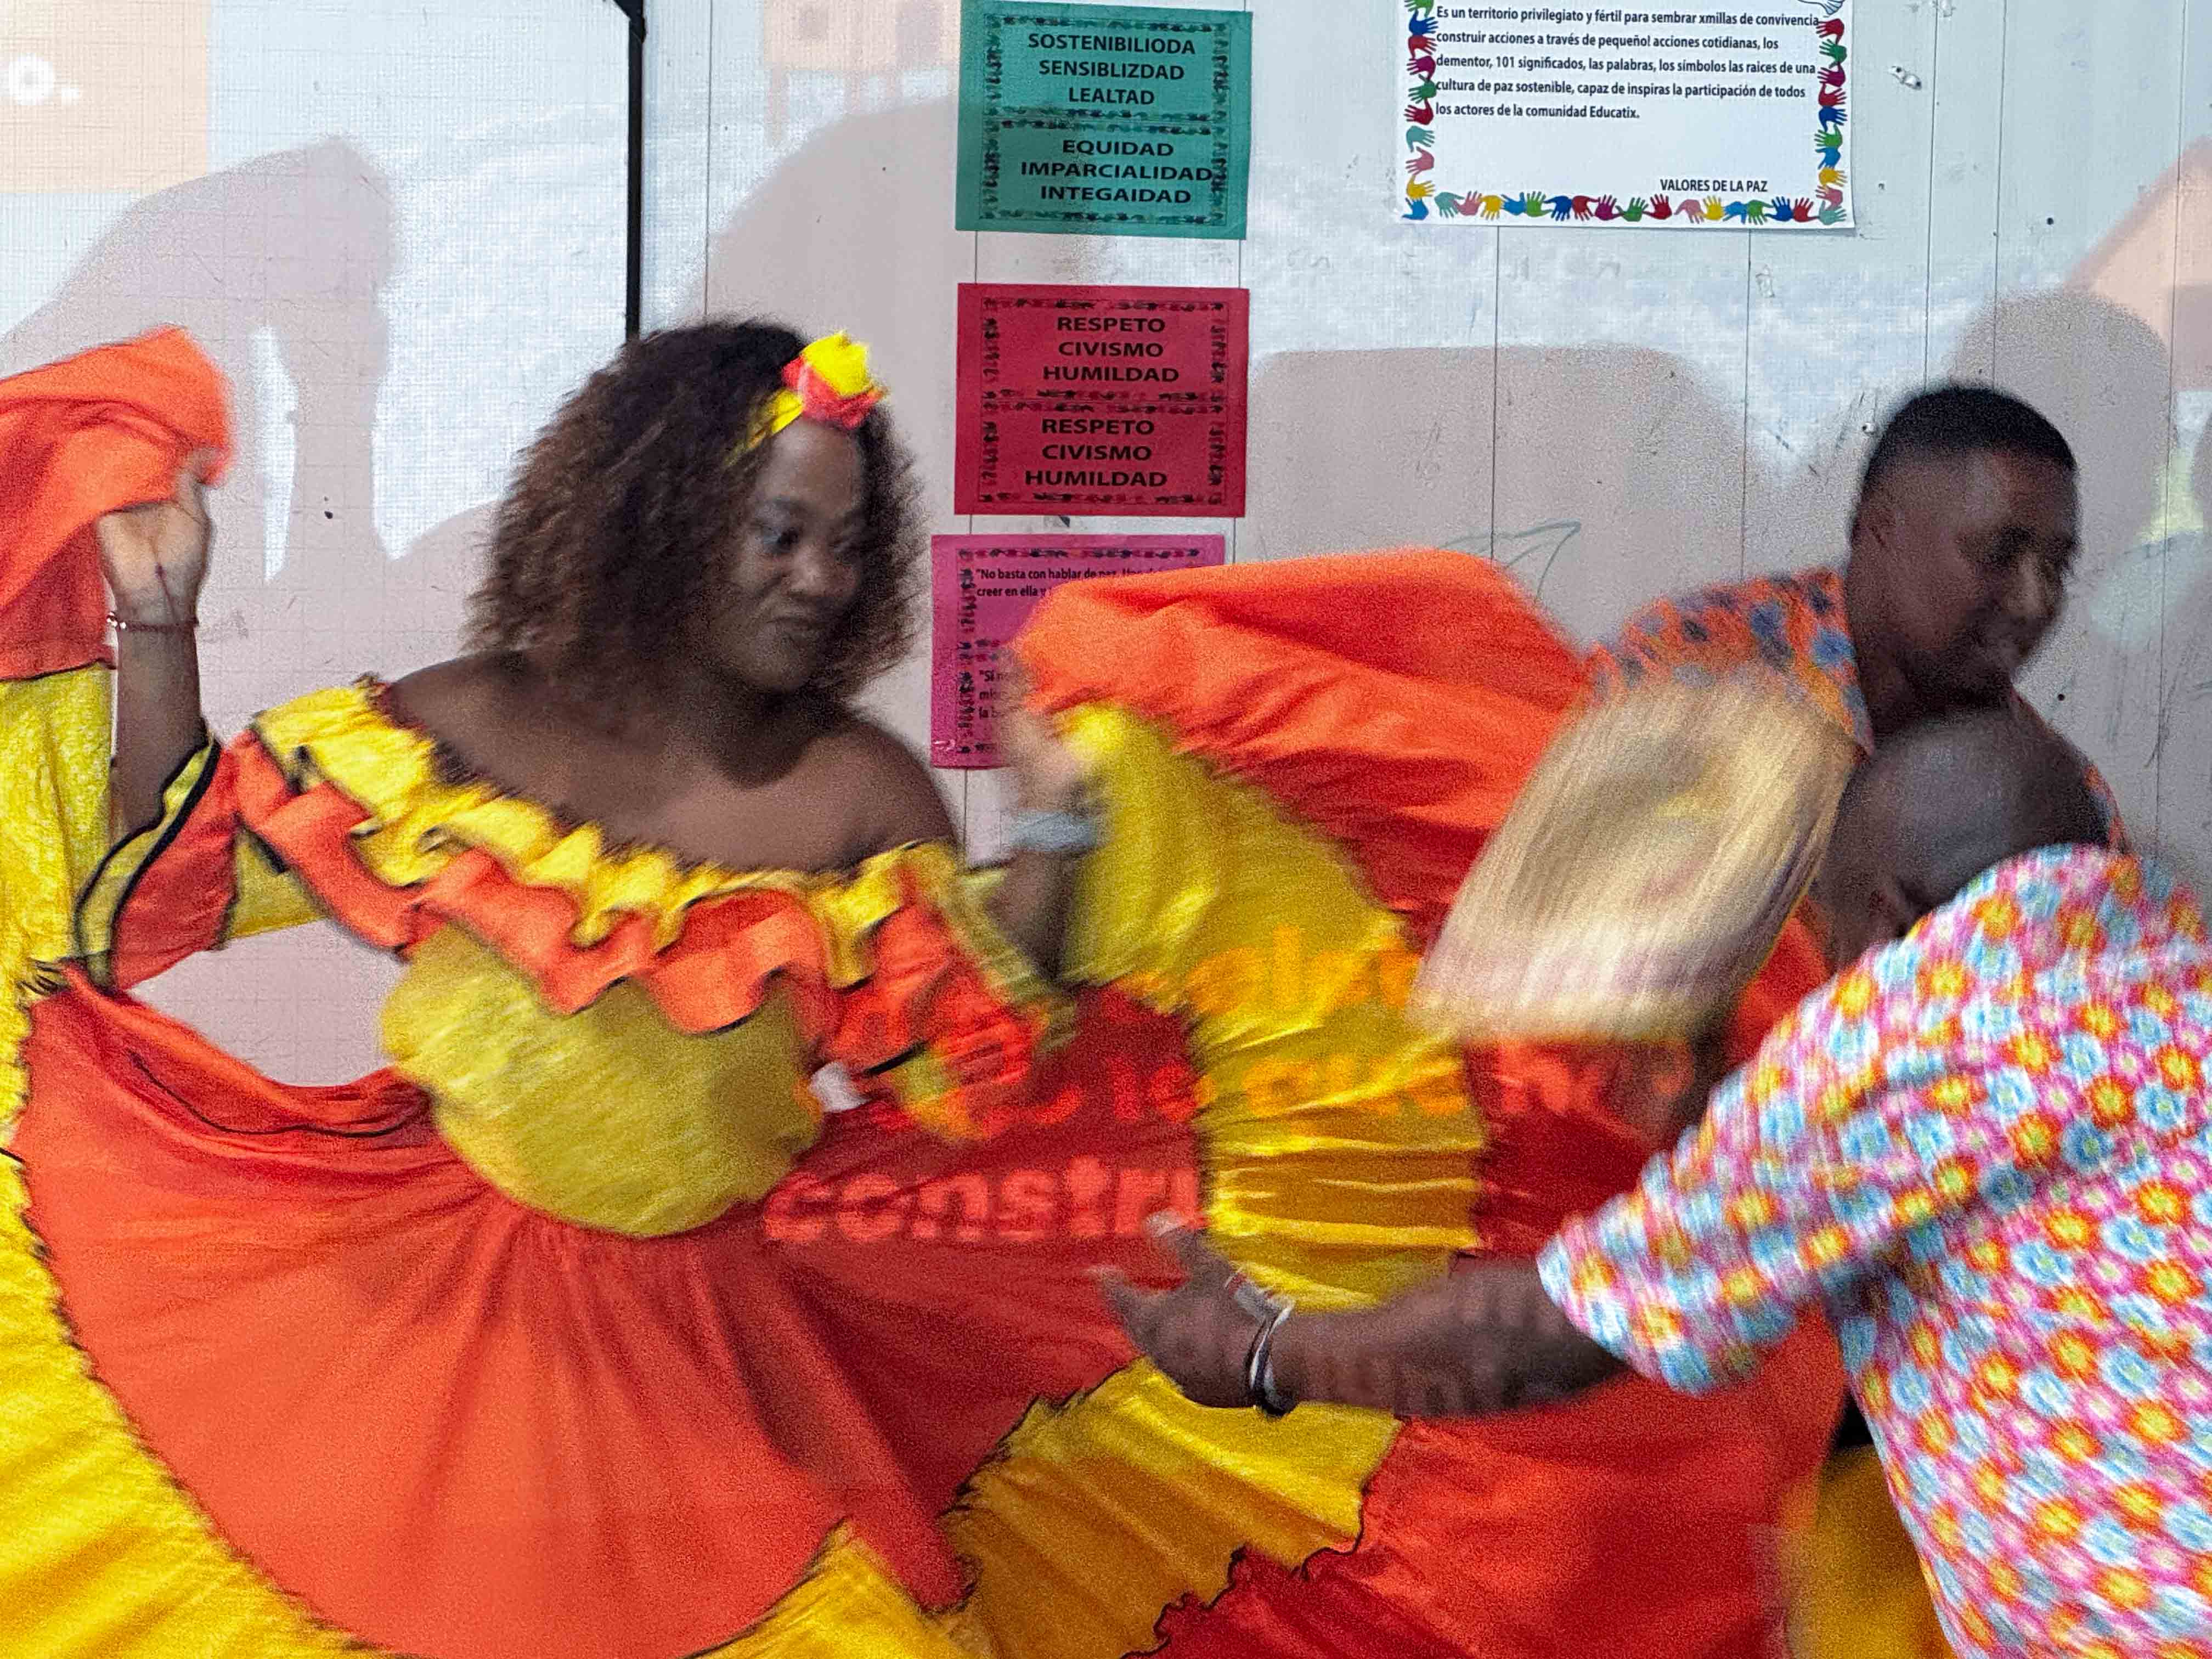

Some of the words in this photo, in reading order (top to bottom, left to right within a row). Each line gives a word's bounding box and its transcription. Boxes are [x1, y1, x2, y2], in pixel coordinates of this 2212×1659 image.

[1437, 5, 1449, 18] Es
[1451, 9, 1465, 18] un
[1468, 7, 1519, 19] territorio
[1520, 8, 1584, 24] privilegiato
[1586, 13, 1593, 25] y
[1594, 9, 1622, 22] fértil
[1624, 13, 1649, 25] para
[1651, 10, 1697, 24] sembrar
[1739, 13, 1753, 25] de
[1756, 14, 1819, 26] convivencia
[1028, 33, 1195, 54] SOSTENIBILIODA
[1436, 30, 1487, 43] construir
[1488, 32, 1535, 44] acciones
[1537, 35, 1544, 44] a
[1546, 33, 1579, 46] través
[1582, 33, 1596, 46] de
[1653, 35, 1700, 48] acciones
[1702, 36, 1760, 50] cotidianas,
[1763, 37, 1779, 49] los
[1039, 60, 1185, 80] SENSIBLIZDAD
[1496, 56, 1515, 68] 101
[1518, 56, 1586, 71] significados,
[1589, 58, 1604, 70] las
[1606, 58, 1656, 73] palabras,
[1659, 59, 1675, 71] los
[1729, 60, 1744, 72] las
[1779, 61, 1793, 74] de
[1796, 64, 1816, 74] una
[1068, 87, 1155, 105] LEALTAD
[1435, 78, 1475, 92] cultura
[1477, 78, 1492, 92] de
[1494, 82, 1514, 95] paz
[1516, 81, 1575, 94] sostenible,
[1577, 84, 1610, 97] capaz
[1611, 82, 1626, 94] de
[1673, 83, 1683, 95] la
[1685, 84, 1757, 99] participación
[1759, 84, 1773, 97] de
[1774, 85, 1805, 98] todos
[1436, 102, 1452, 115] los
[1454, 105, 1494, 116] actores
[1497, 104, 1511, 116] de
[1513, 104, 1523, 116] la
[1526, 105, 1587, 117] comunidad
[1589, 105, 1640, 119] Educatix.
[1063, 140, 1174, 157] EQUIDAD
[1021, 161, 1212, 181] IMPARCIALIDAD
[1660, 179, 1710, 191] VALORES
[1712, 179, 1728, 192] DE
[1730, 180, 1744, 192] LA
[1746, 180, 1768, 193] PAZ
[1057, 316, 1165, 333] RESPETO
[1058, 341, 1164, 357] CIVISMO
[1043, 366, 1179, 382] HUMILDAD
[1042, 419, 1154, 435] RESPETO
[1042, 444, 1152, 460] CIVISMO
[1025, 470, 1167, 487] HUMILDAD
[997, 568, 1026, 579] basta
[1028, 571, 1046, 579] con
[1048, 567, 1081, 579] hablar
[1084, 567, 1097, 578] de
[977, 588, 1003, 597] creer
[1005, 588, 1018, 597] en
[1020, 584, 1038, 597] ella
